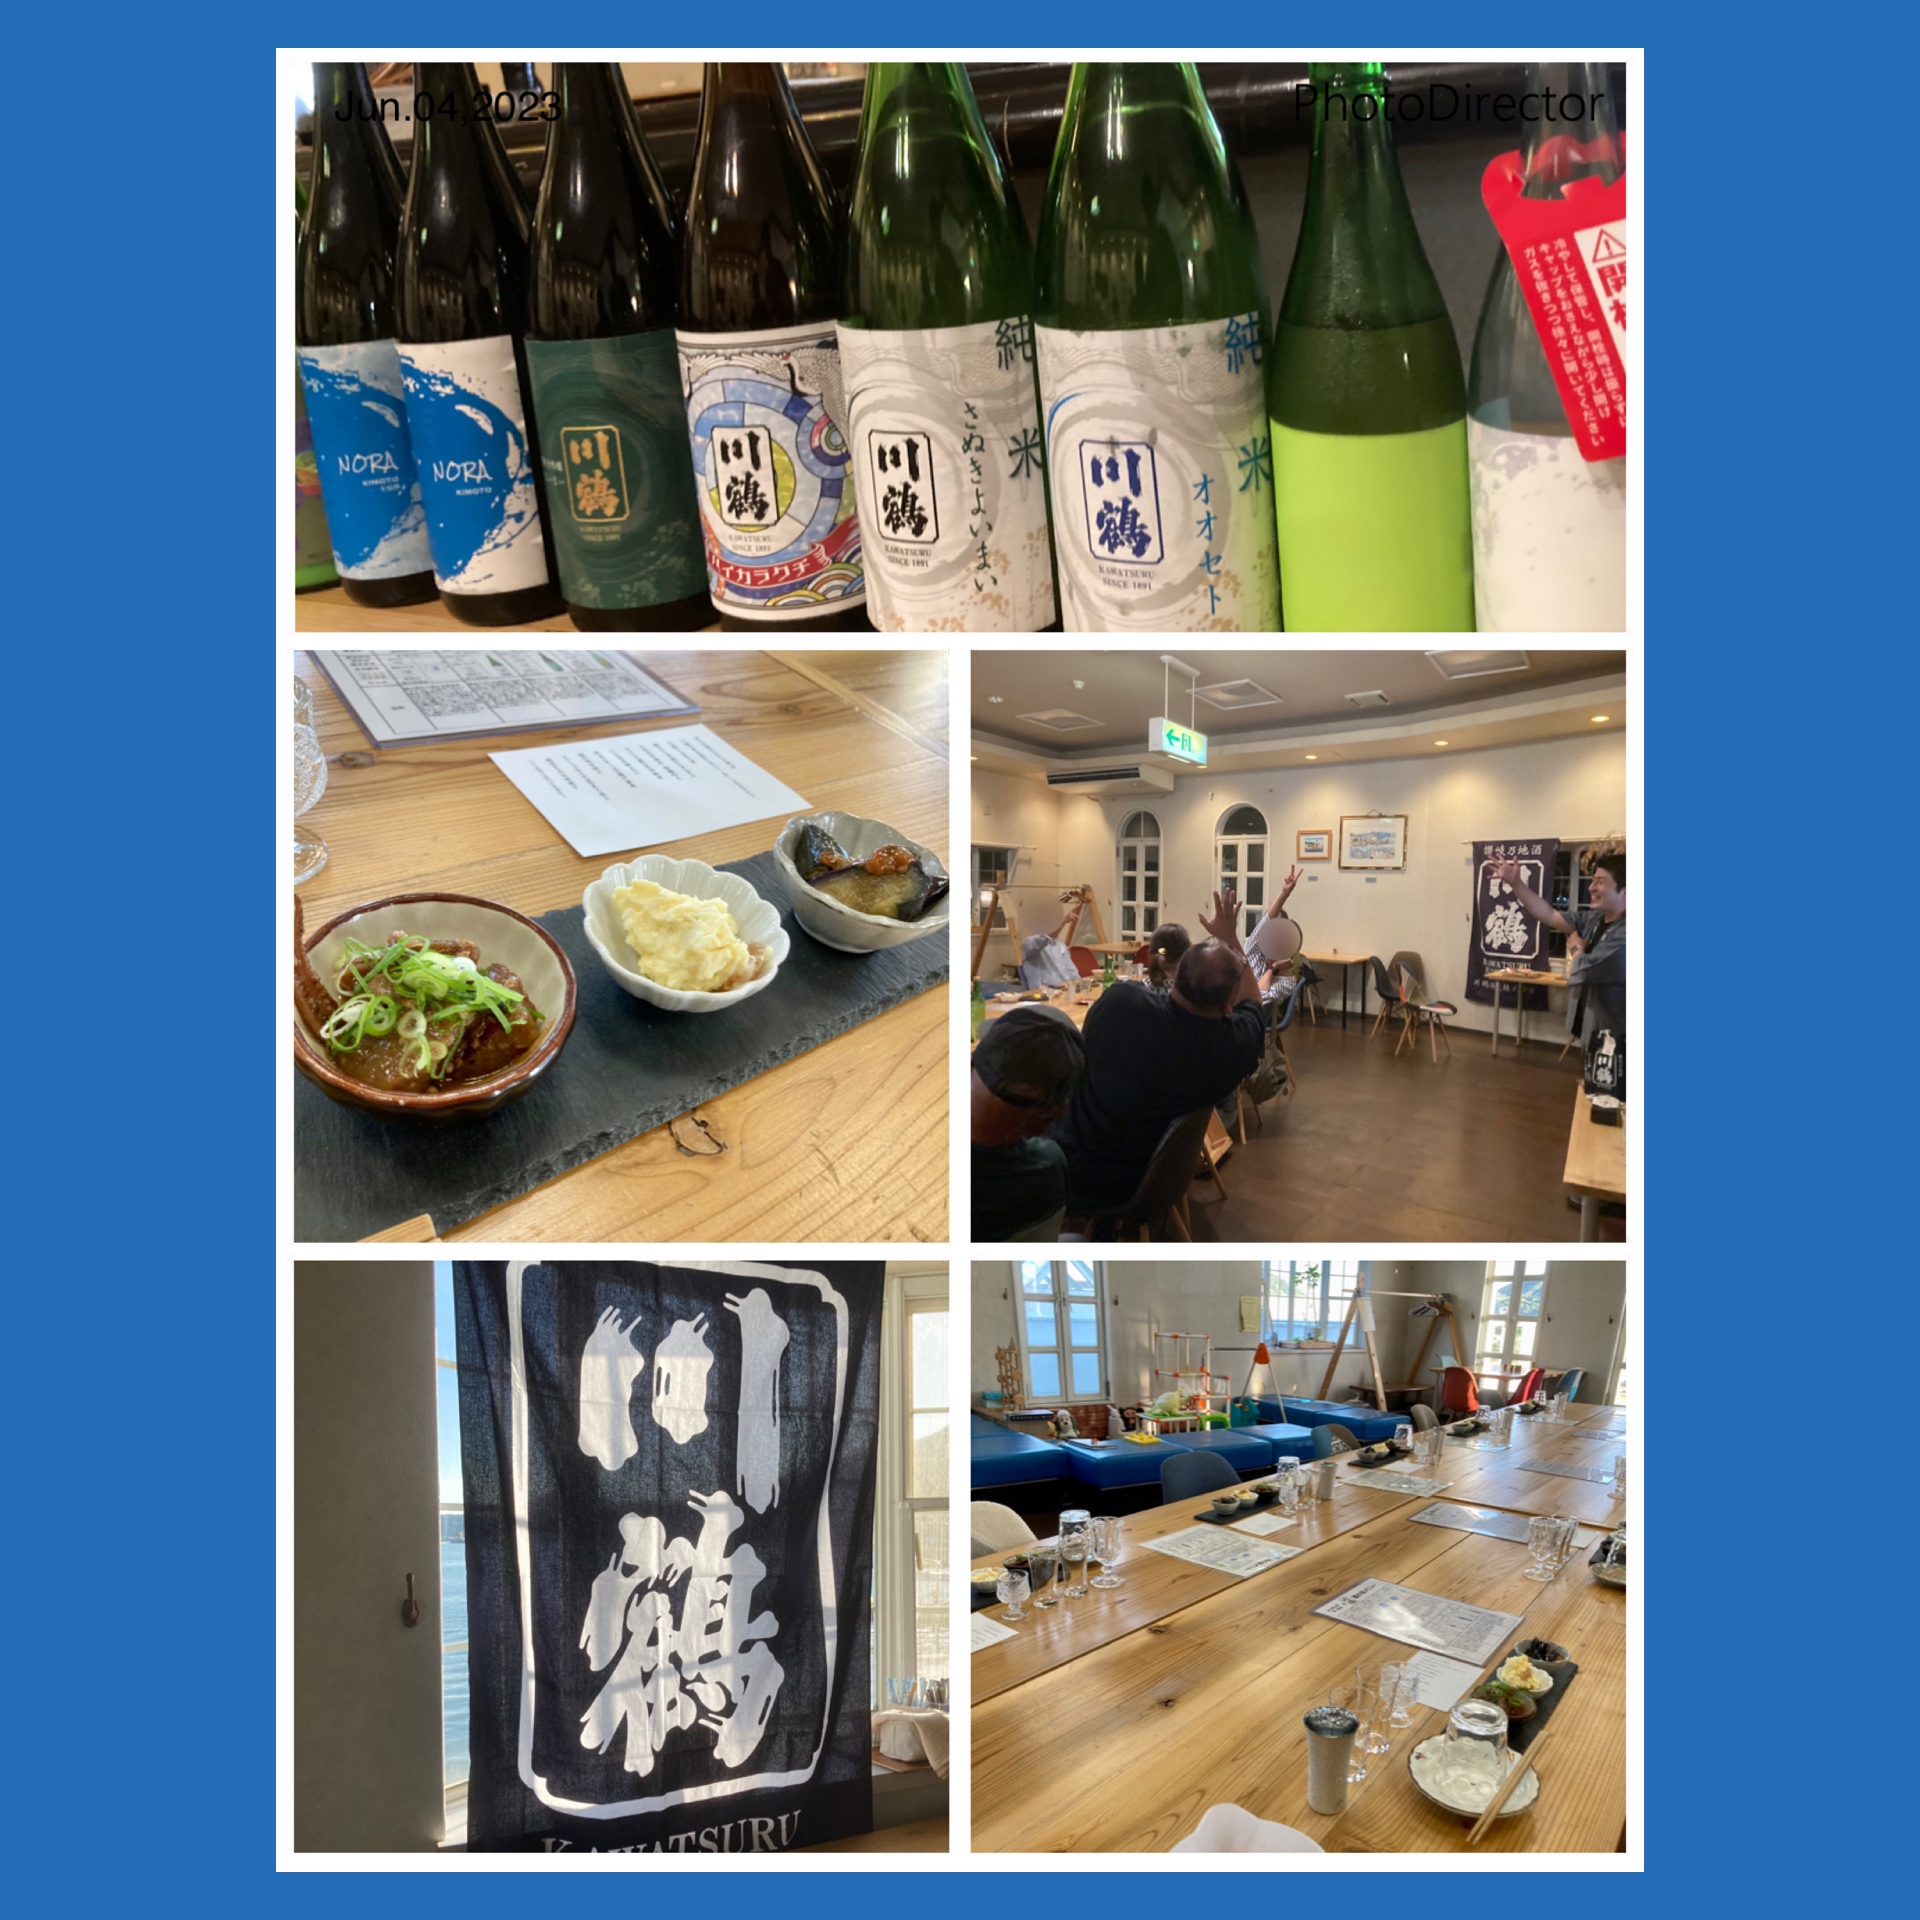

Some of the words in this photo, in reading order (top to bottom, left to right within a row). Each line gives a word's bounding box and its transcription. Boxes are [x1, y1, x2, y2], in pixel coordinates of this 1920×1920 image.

[338, 450, 400, 475] NORA
[432, 459, 493, 483] NORA
[456, 486, 493, 496] KIMOTO
[569, 430, 619, 517] 川鶴
[720, 431, 769, 521] 川鶴
[878, 437, 928, 538] 川鶴
[961, 402, 998, 592] さぬきよいまい
[1090, 448, 1151, 558] 川鶴
[710, 554, 811, 585] ハイカラクチ
[884, 544, 932, 557] KAWATSURU
[1098, 565, 1155, 579] KAWATSURU
[1192, 473, 1222, 616] オオセト
[1102, 577, 1130, 589] SINCE
[1132, 581, 1152, 591] 1891
[578, 1287, 791, 1777] 川鶴
